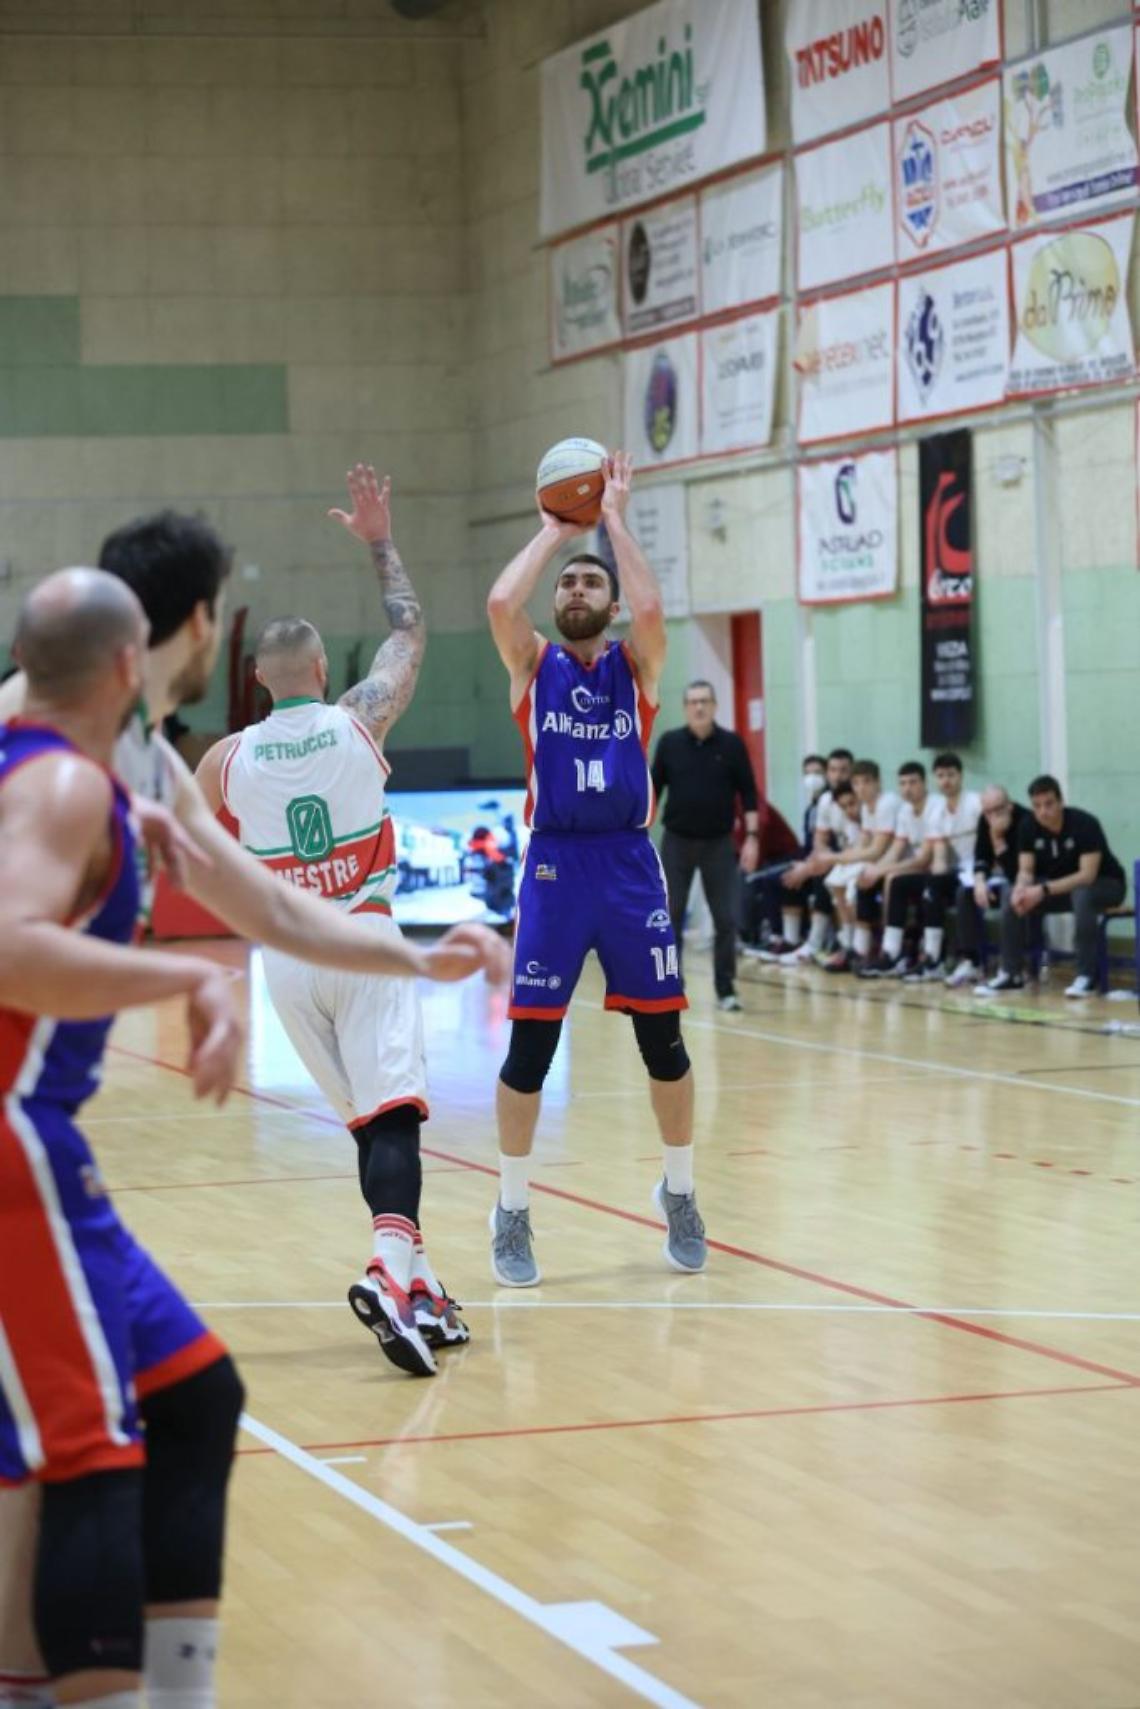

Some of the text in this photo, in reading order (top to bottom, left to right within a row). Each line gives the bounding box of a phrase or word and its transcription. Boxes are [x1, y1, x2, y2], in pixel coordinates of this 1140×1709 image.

[795, 15, 885, 88] TATSUNO
[542, 711, 611, 740] Allianz
[254, 729, 338, 761] PETRUCCI
[574, 758, 606, 792] 14
[650, 945, 679, 980] 14
